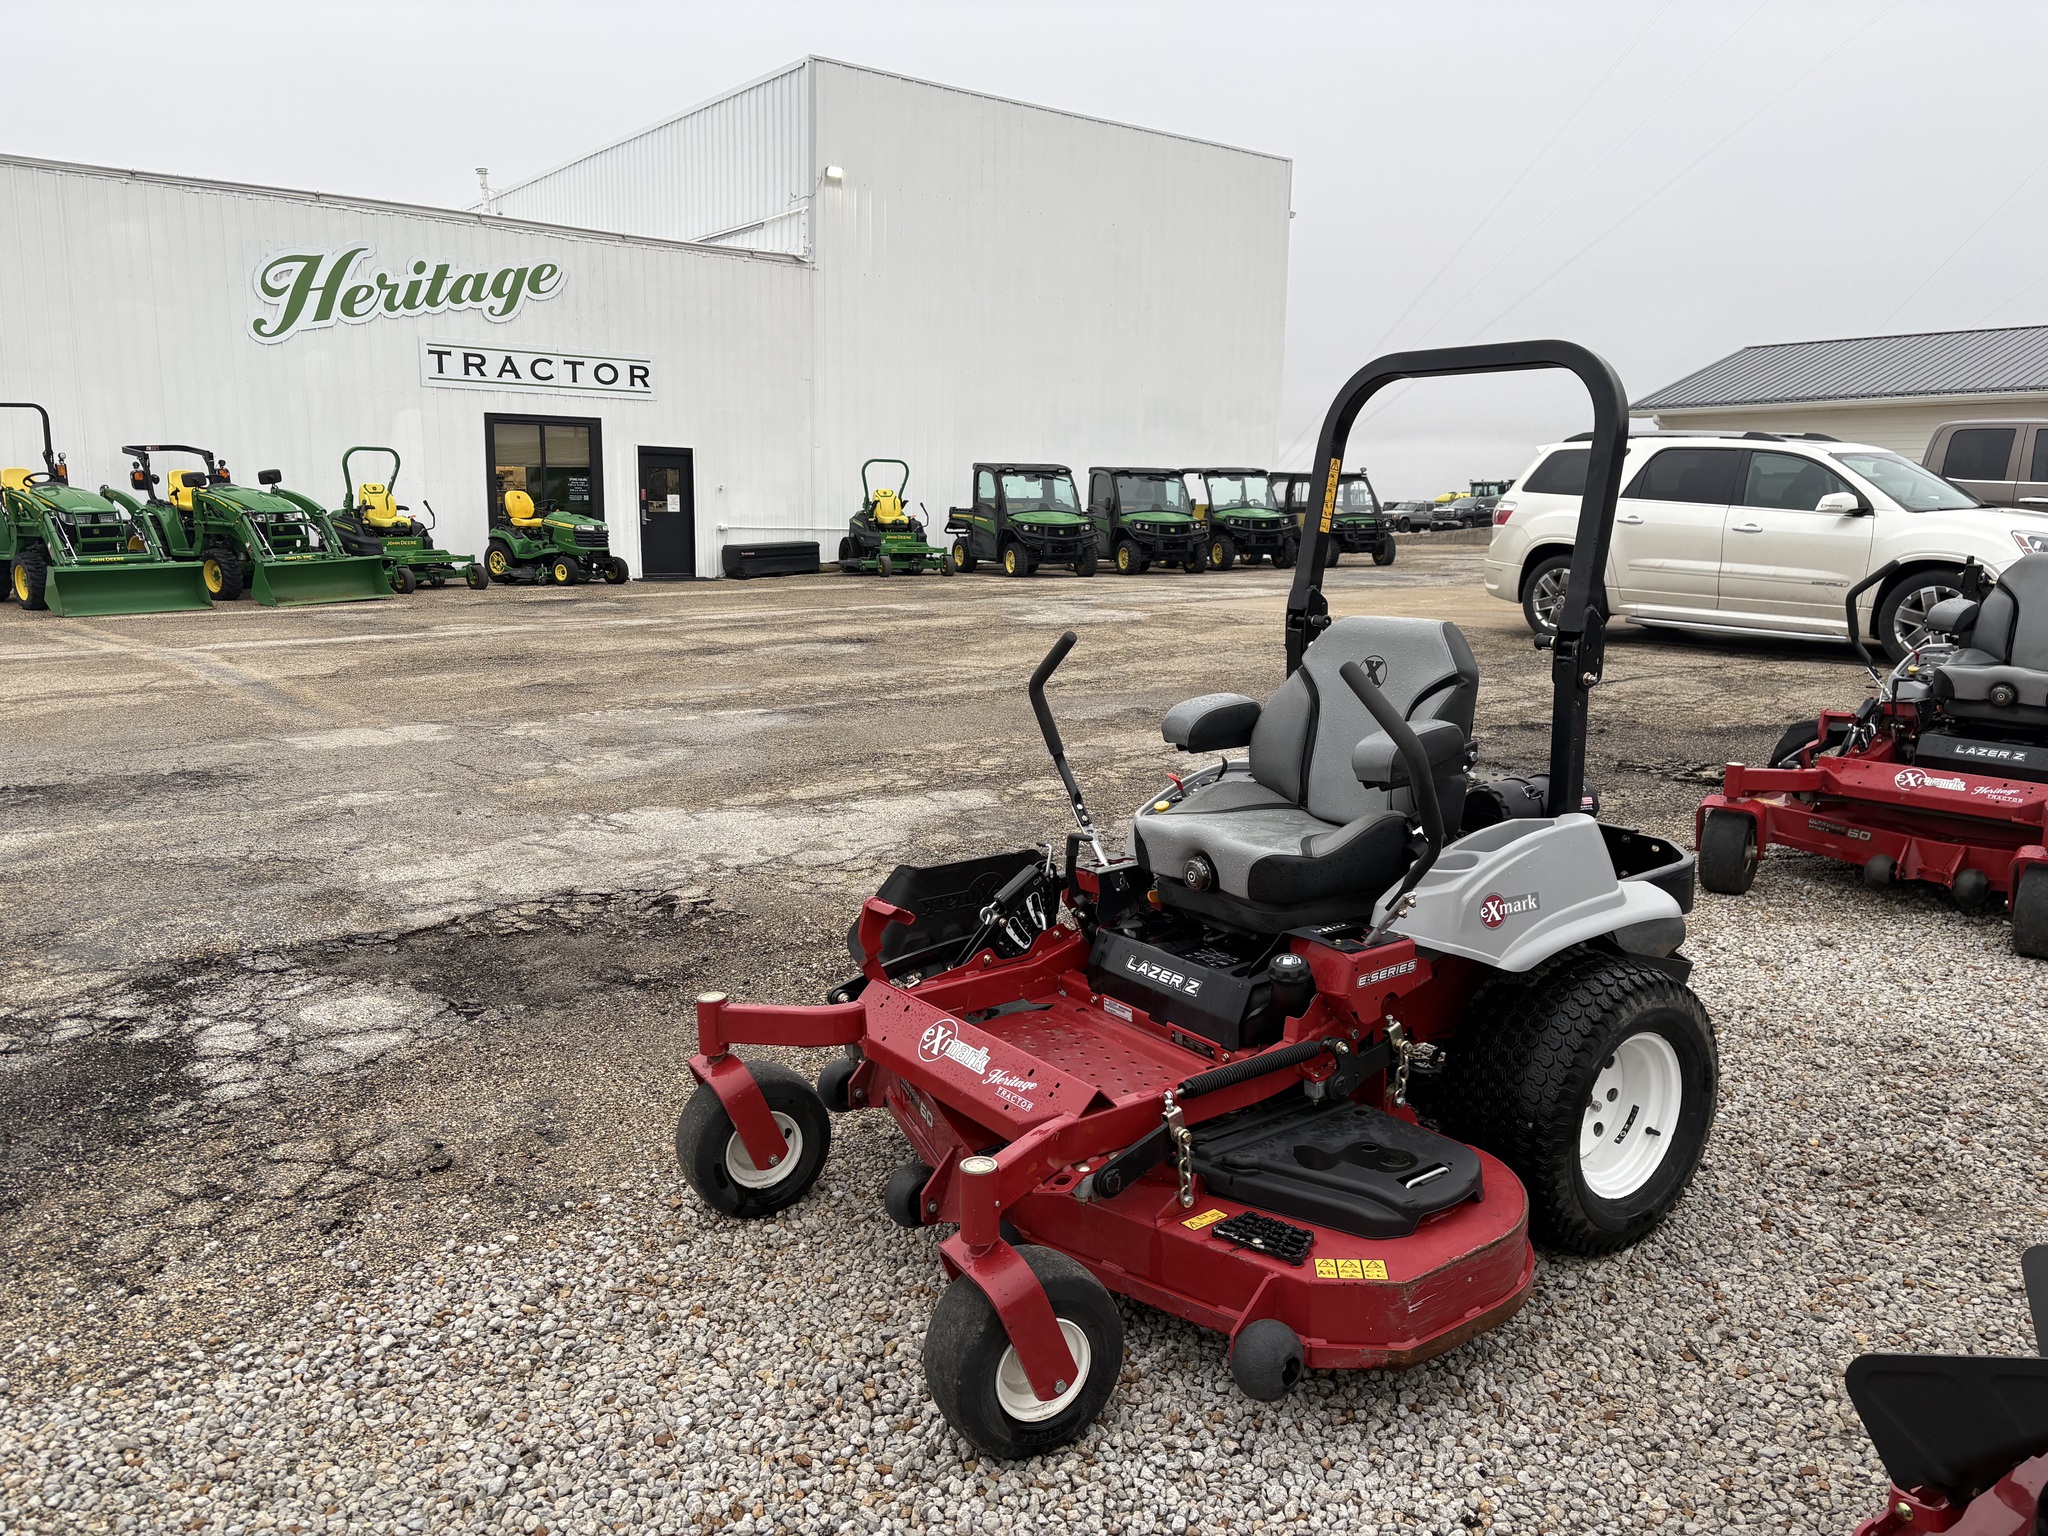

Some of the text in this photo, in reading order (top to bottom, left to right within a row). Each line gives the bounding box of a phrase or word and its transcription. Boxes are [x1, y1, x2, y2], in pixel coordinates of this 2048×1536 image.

[252, 247, 563, 338] Heritage
[427, 348, 651, 388] TRACTOR
[1954, 744, 2027, 762] LAZER Z
[1970, 785, 2020, 796] Heritage
[1986, 793, 2024, 804] TRACTOR
[1480, 894, 1538, 923] eXmark
[1125, 955, 1185, 990] LAZER
[1183, 977, 1202, 997] Z
[919, 1021, 990, 1074] eXmark
[982, 1068, 1038, 1092] Heritage
[996, 1087, 1034, 1112] TRACTOR
